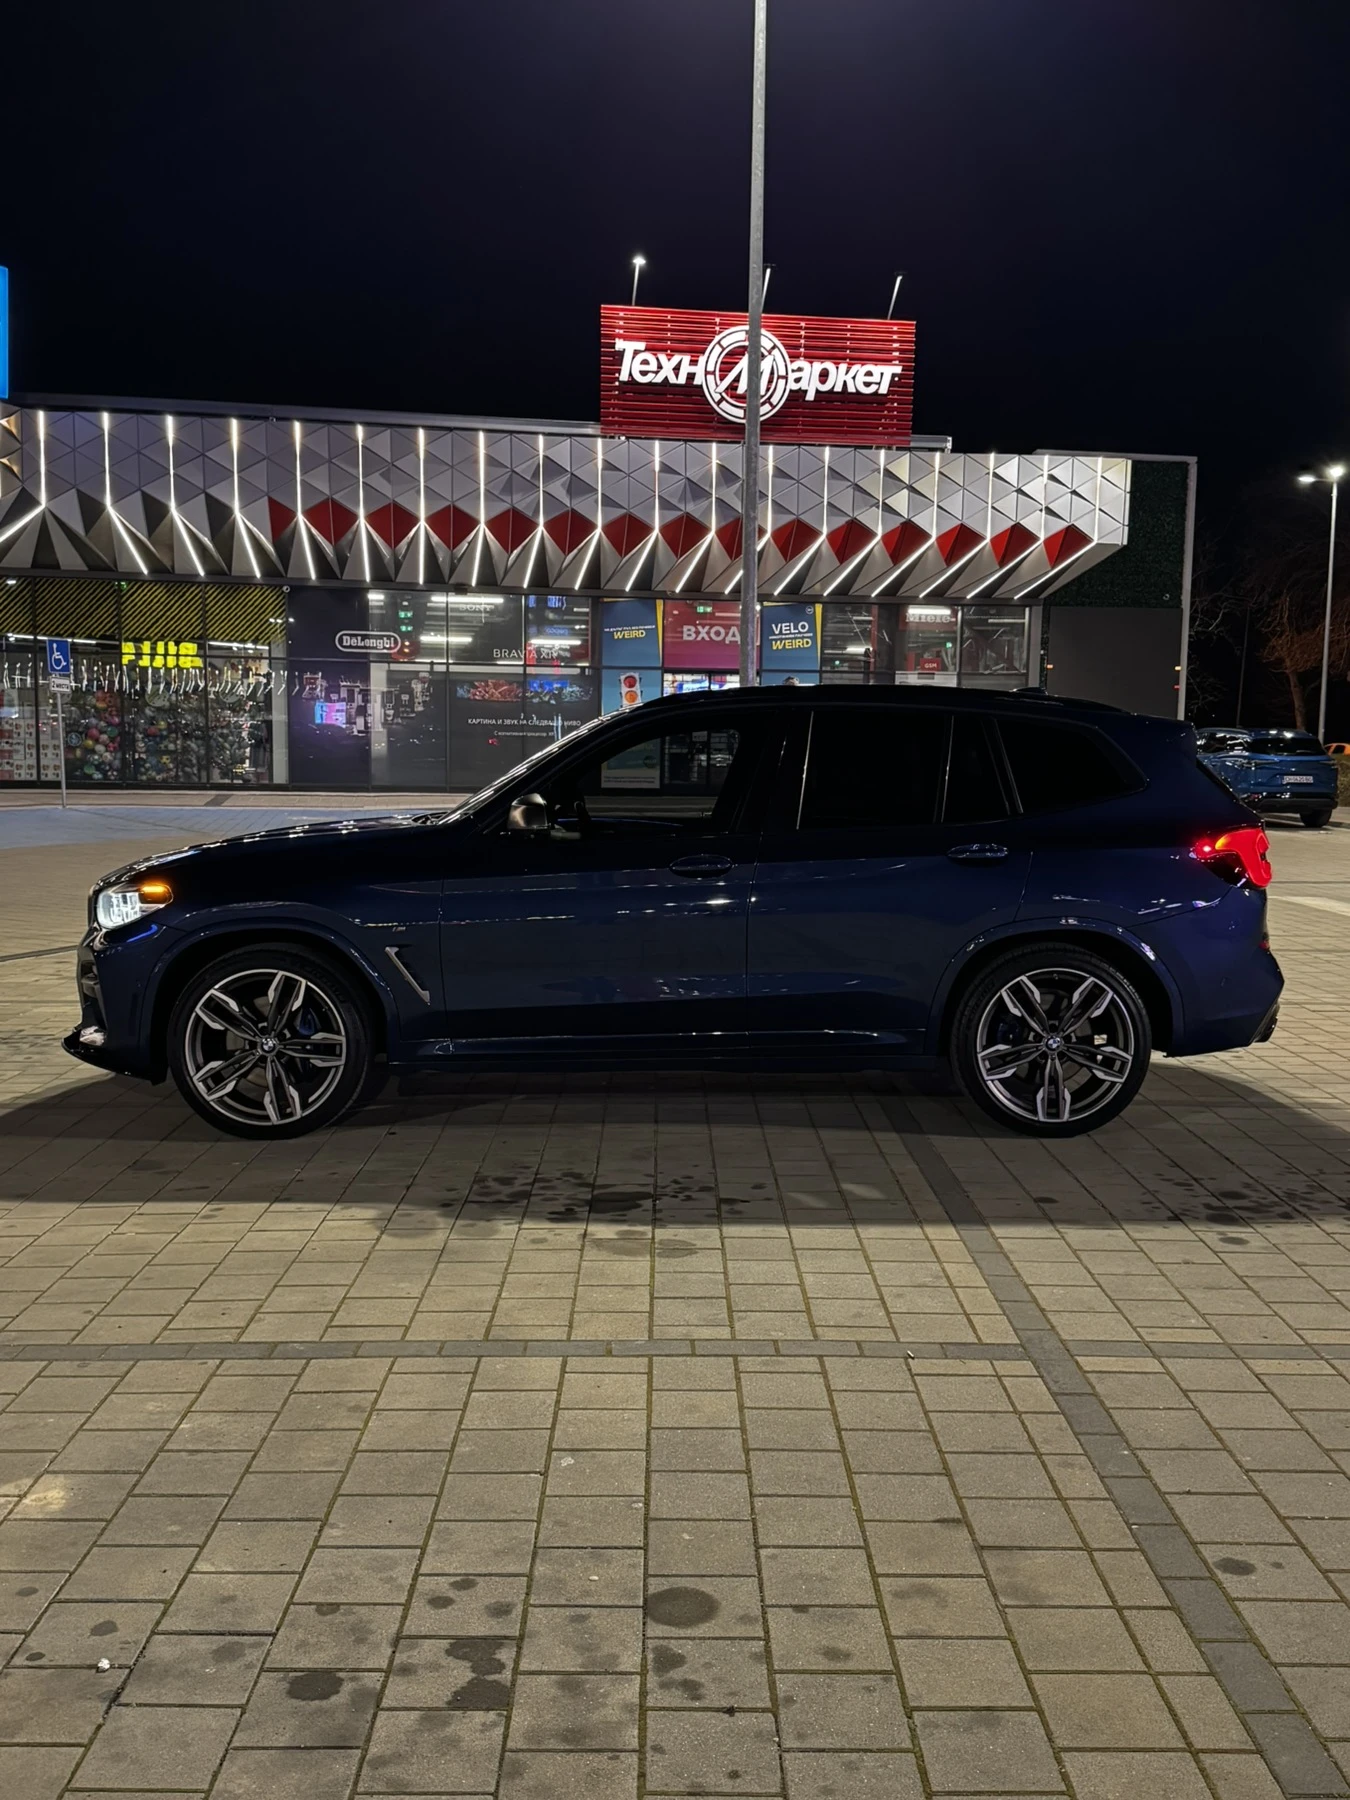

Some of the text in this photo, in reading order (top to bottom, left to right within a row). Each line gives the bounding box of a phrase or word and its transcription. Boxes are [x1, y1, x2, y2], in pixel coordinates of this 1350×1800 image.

[772, 621, 809, 635] VELO
[613, 630, 646, 640] WEIRD
[682, 625, 741, 644] ВХОД
[772, 638, 812, 650] WEIRD
[493, 648, 538, 659] BRAVIA
